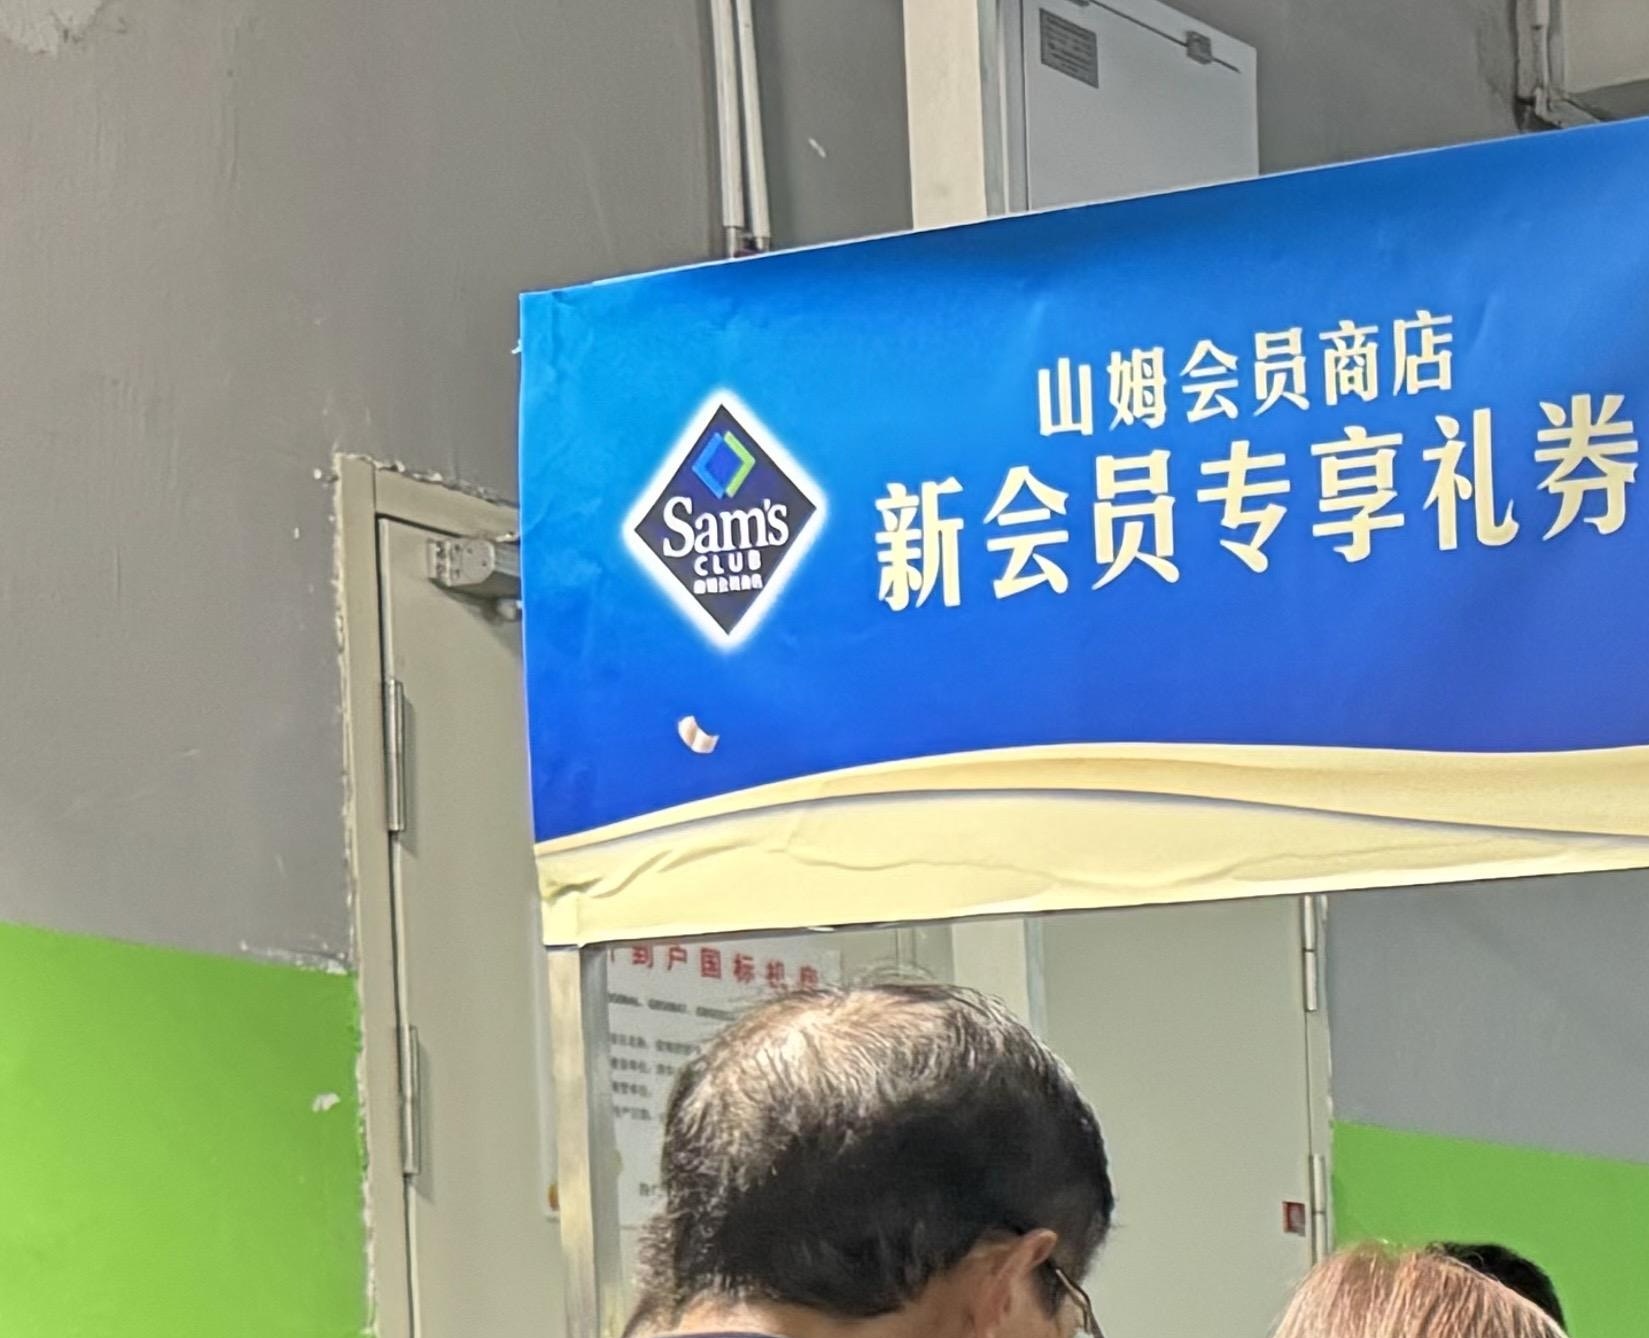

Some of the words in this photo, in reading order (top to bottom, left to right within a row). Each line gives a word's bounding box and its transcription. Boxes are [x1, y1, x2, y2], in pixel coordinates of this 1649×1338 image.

[1038, 310, 1454, 437] 山姆会员商店
[662, 496, 790, 558] Sam's
[875, 394, 1640, 611] 新会员专享礼券
[694, 549, 762, 577] CLUB
[610, 944, 820, 992] 到户国标机房
